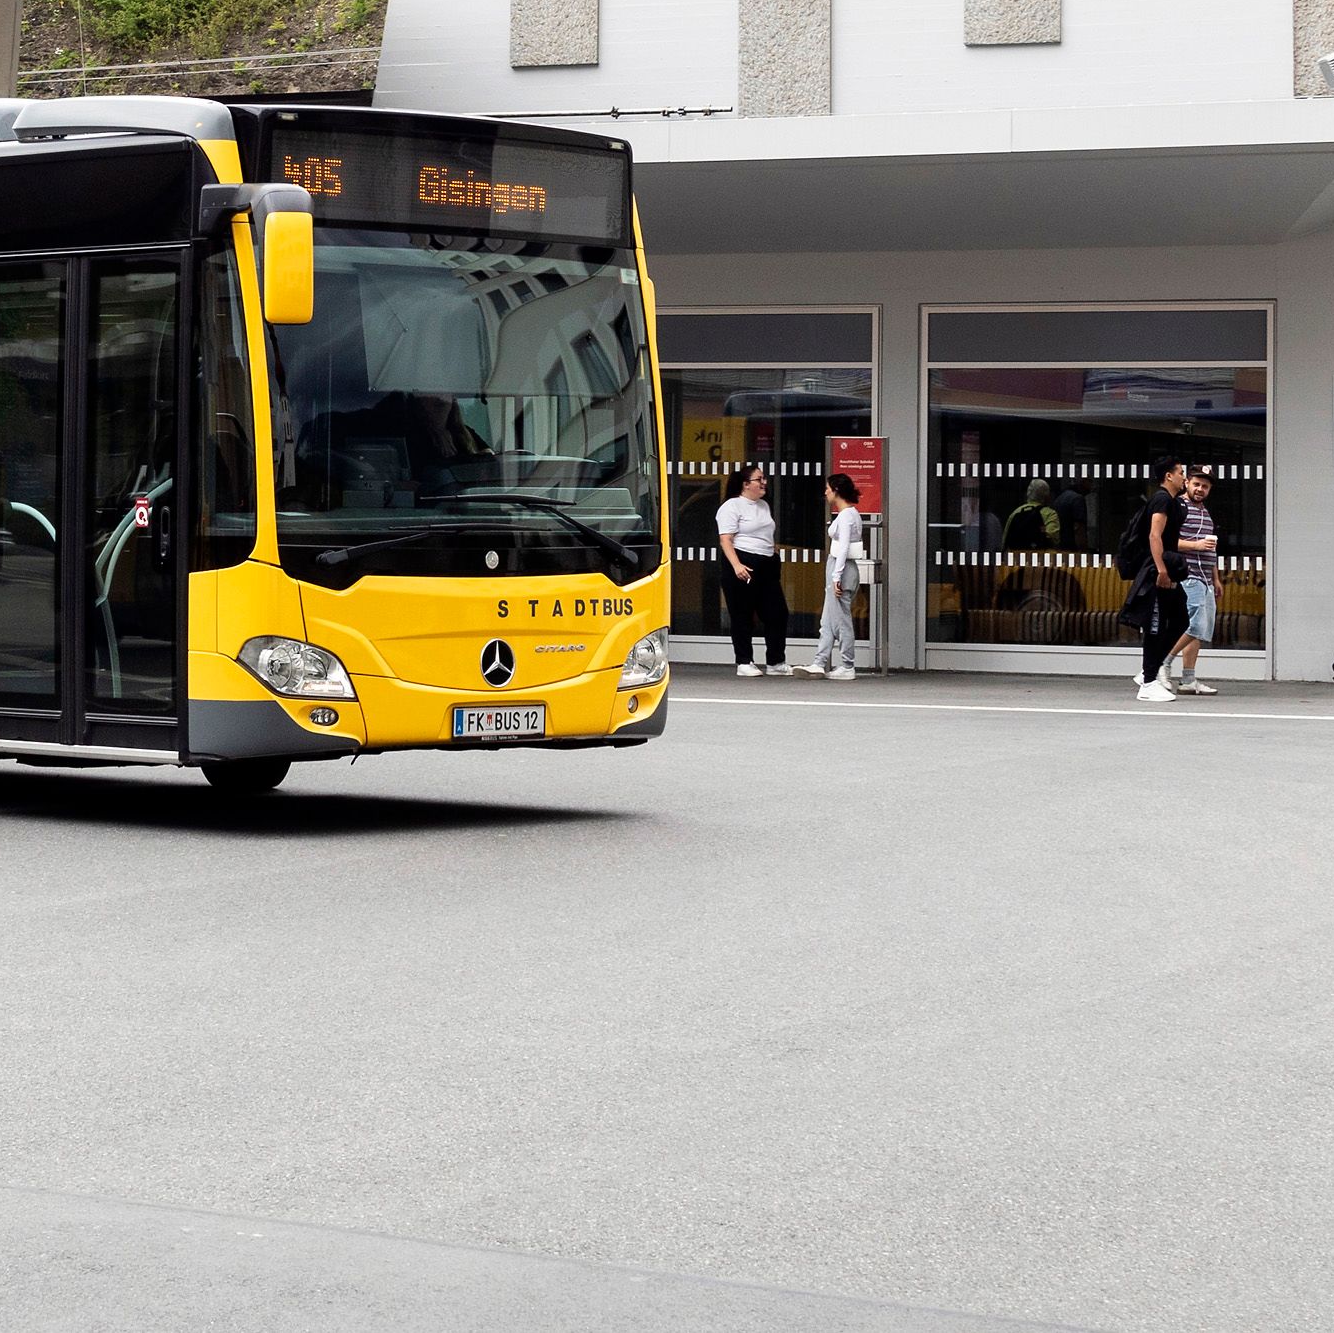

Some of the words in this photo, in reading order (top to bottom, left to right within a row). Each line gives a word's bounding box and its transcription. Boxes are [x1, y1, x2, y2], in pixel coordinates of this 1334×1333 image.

[284, 155, 342, 196] 405
[419, 165, 546, 213] Gisingen
[534, 644, 586, 653] CITARO
[468, 713, 485, 732] FK
[495, 712, 521, 730] BUS
[524, 711, 538, 730] 12
